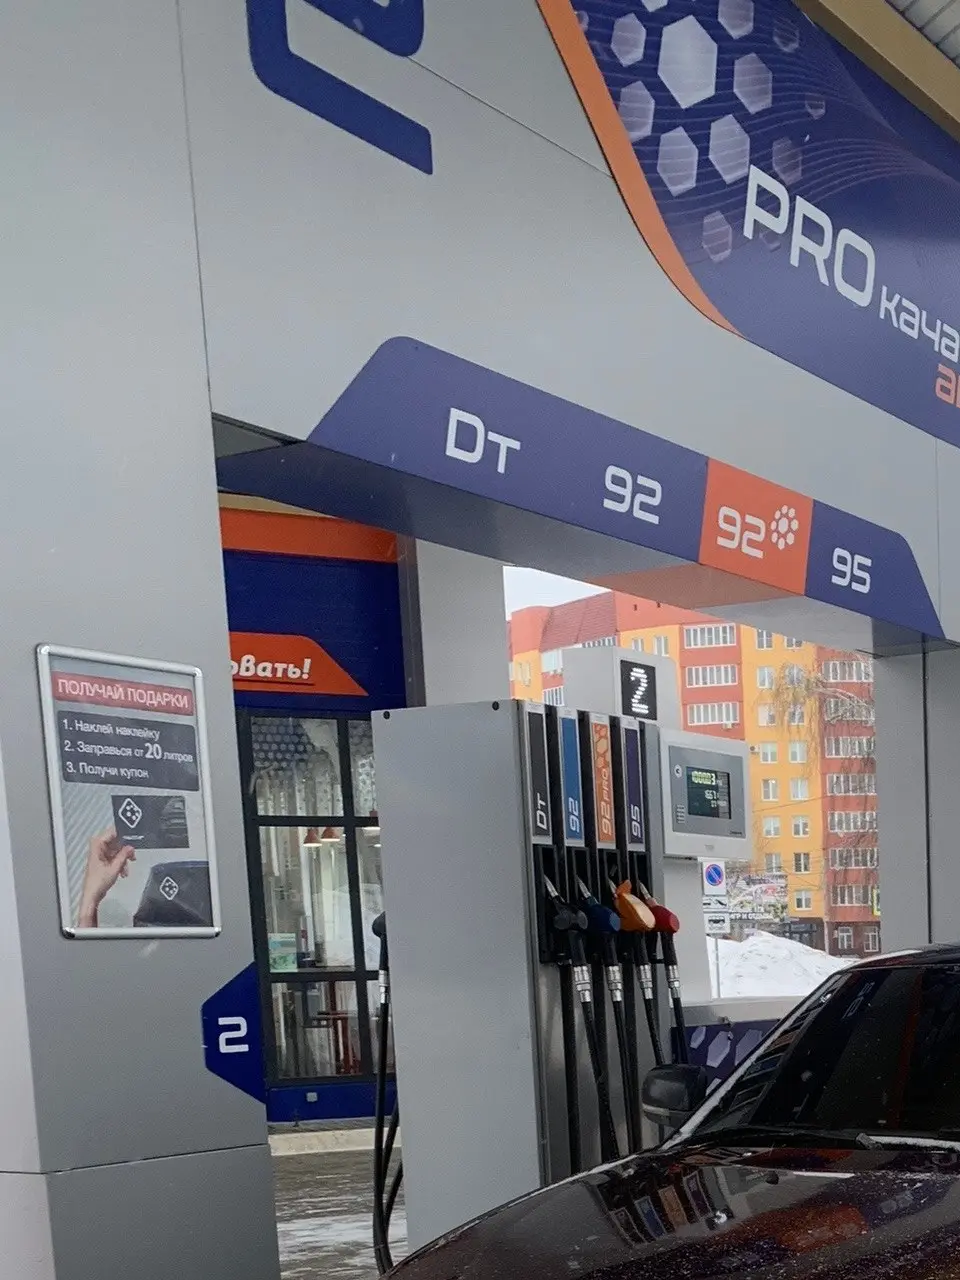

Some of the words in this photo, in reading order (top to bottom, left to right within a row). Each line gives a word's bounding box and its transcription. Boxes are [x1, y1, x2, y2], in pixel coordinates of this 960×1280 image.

[743, 164, 876, 307] PRO
[603, 465, 663, 525] 92
[716, 505, 766, 559] 92
[831, 547, 873, 594] 95
[58, 679, 125, 700] ПОЛУЧАЙ
[127, 688, 188, 708] ПОДАРКИ
[630, 667, 649, 714] 2
[62, 719, 73, 730] 1.
[75, 720, 114, 734] Наклей
[115, 727, 160, 741] наклейку
[64, 740, 75, 752] 2.
[77, 741, 132, 757] Заправься
[134, 748, 144, 757] от
[144, 742, 162, 759] 20
[163, 750, 194, 763] литров
[66, 761, 77, 773] 3.
[79, 762, 119, 779] Получи
[120, 769, 150, 780] купон
[568, 797, 580, 833] 92
[600, 801, 612, 836] 92
[630, 804, 641, 838] 95
[217, 1016, 250, 1054] 2
